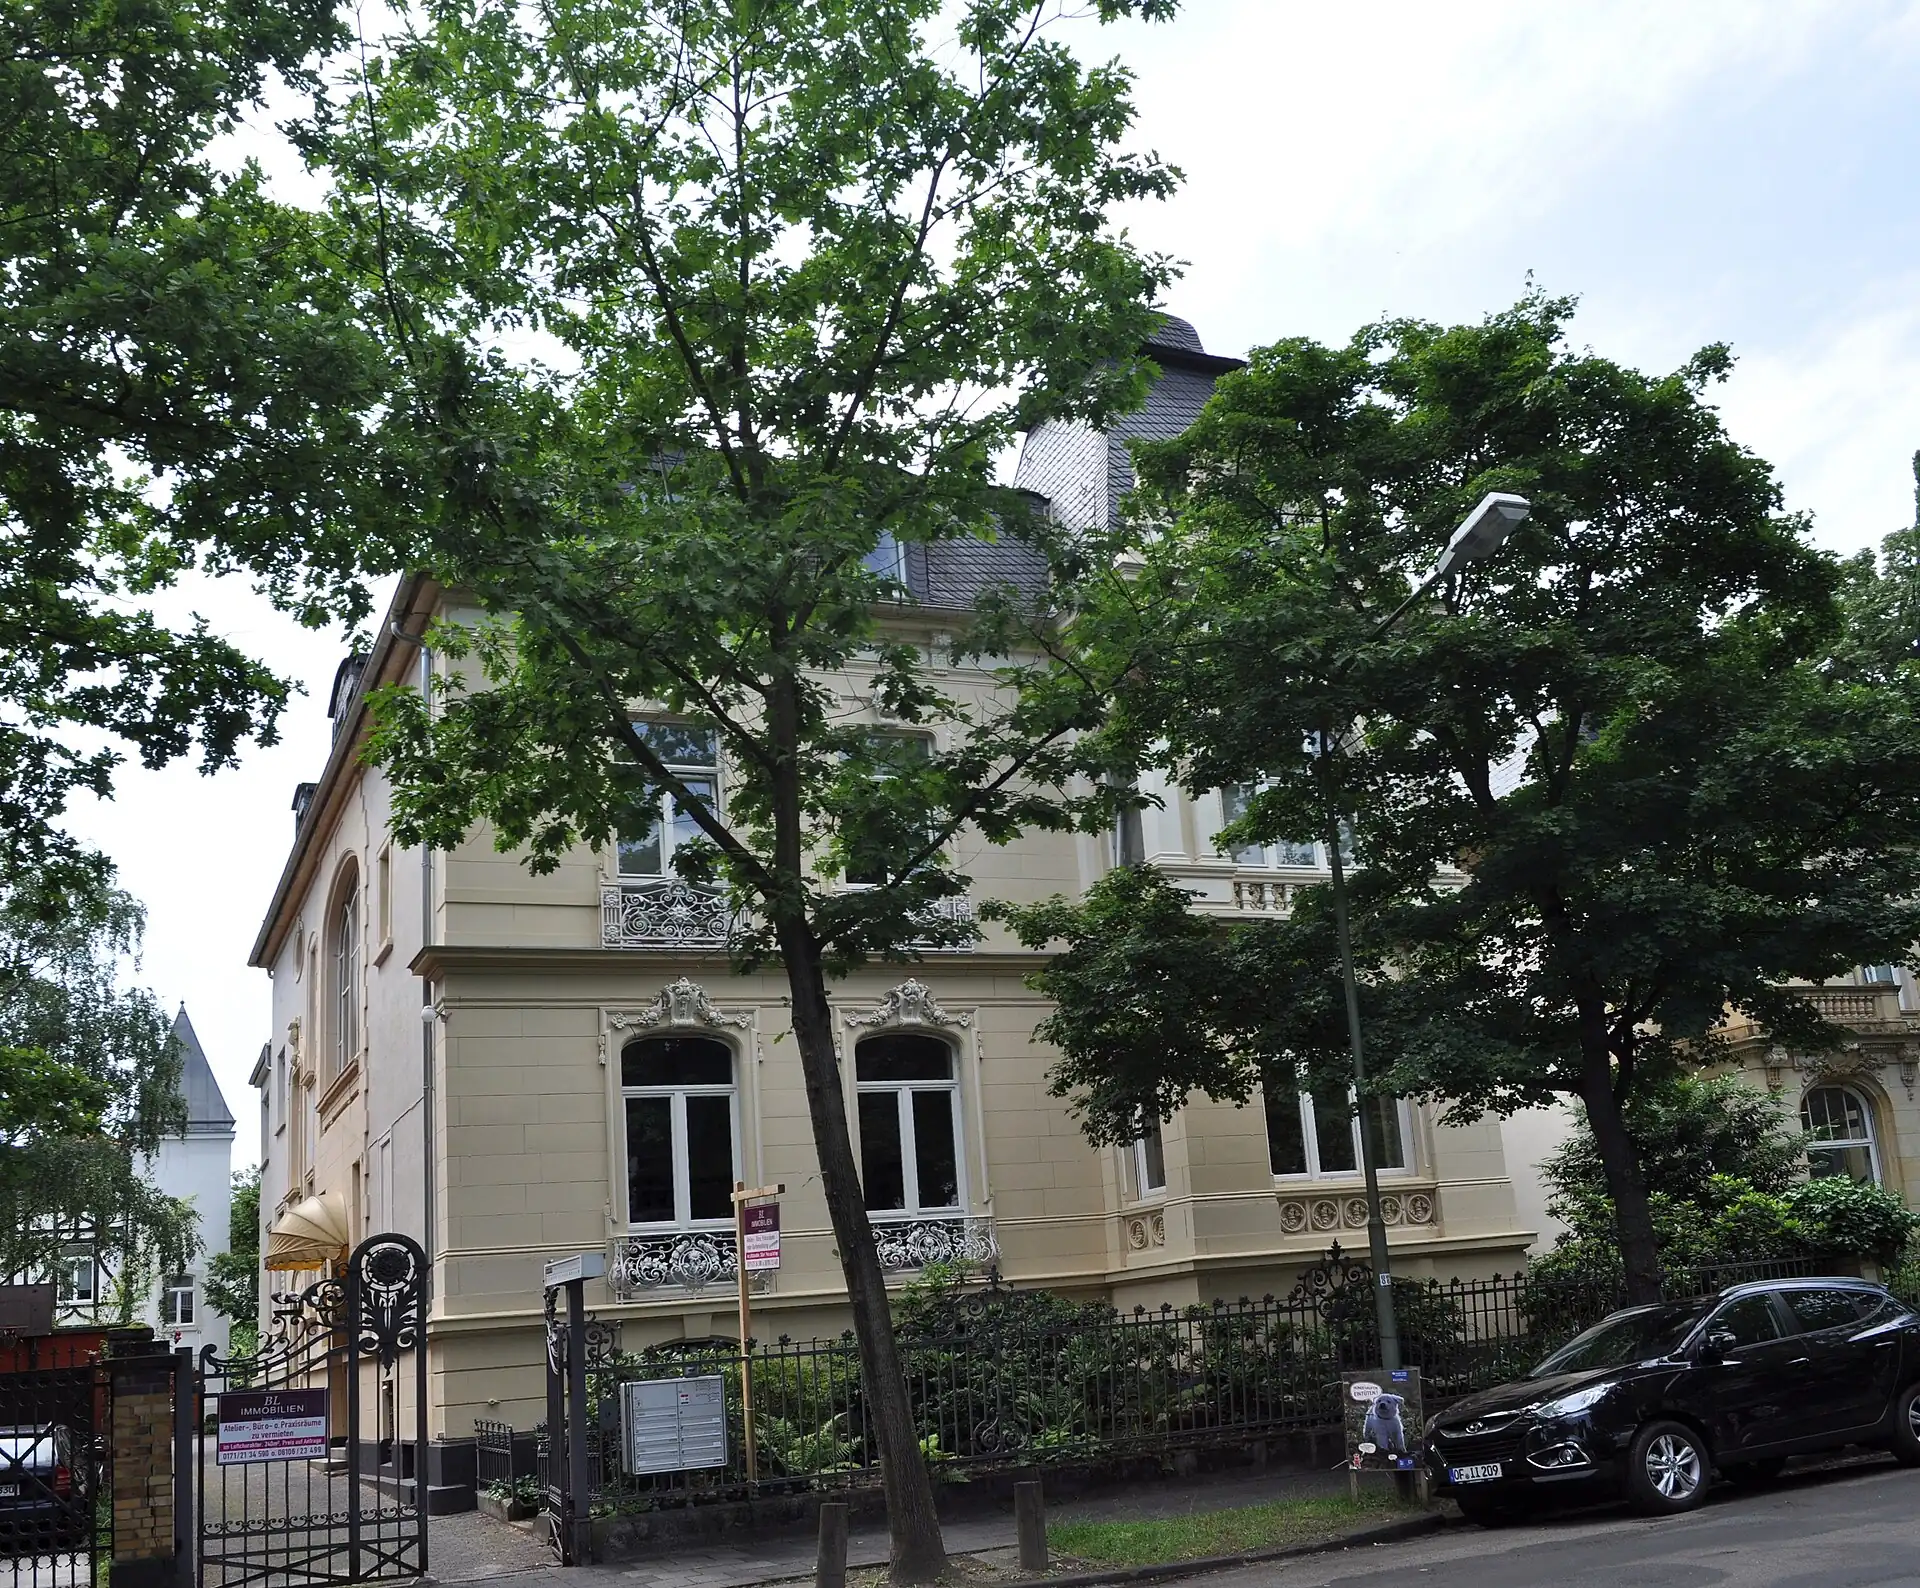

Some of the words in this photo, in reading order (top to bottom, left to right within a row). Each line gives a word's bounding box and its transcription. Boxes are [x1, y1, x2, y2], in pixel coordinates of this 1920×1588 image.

[264, 1396, 281, 1405] BL
[240, 1405, 304, 1415] IMMOBILIEN
[252, 1422, 273, 1431] Büro-
[281, 1419, 322, 1428] Praxisräume
[261, 1430, 294, 1439] vermieten
[248, 1450, 257, 1458] 34
[1454, 1468, 1464, 1480] OF
[1481, 1464, 1499, 1477] 209
